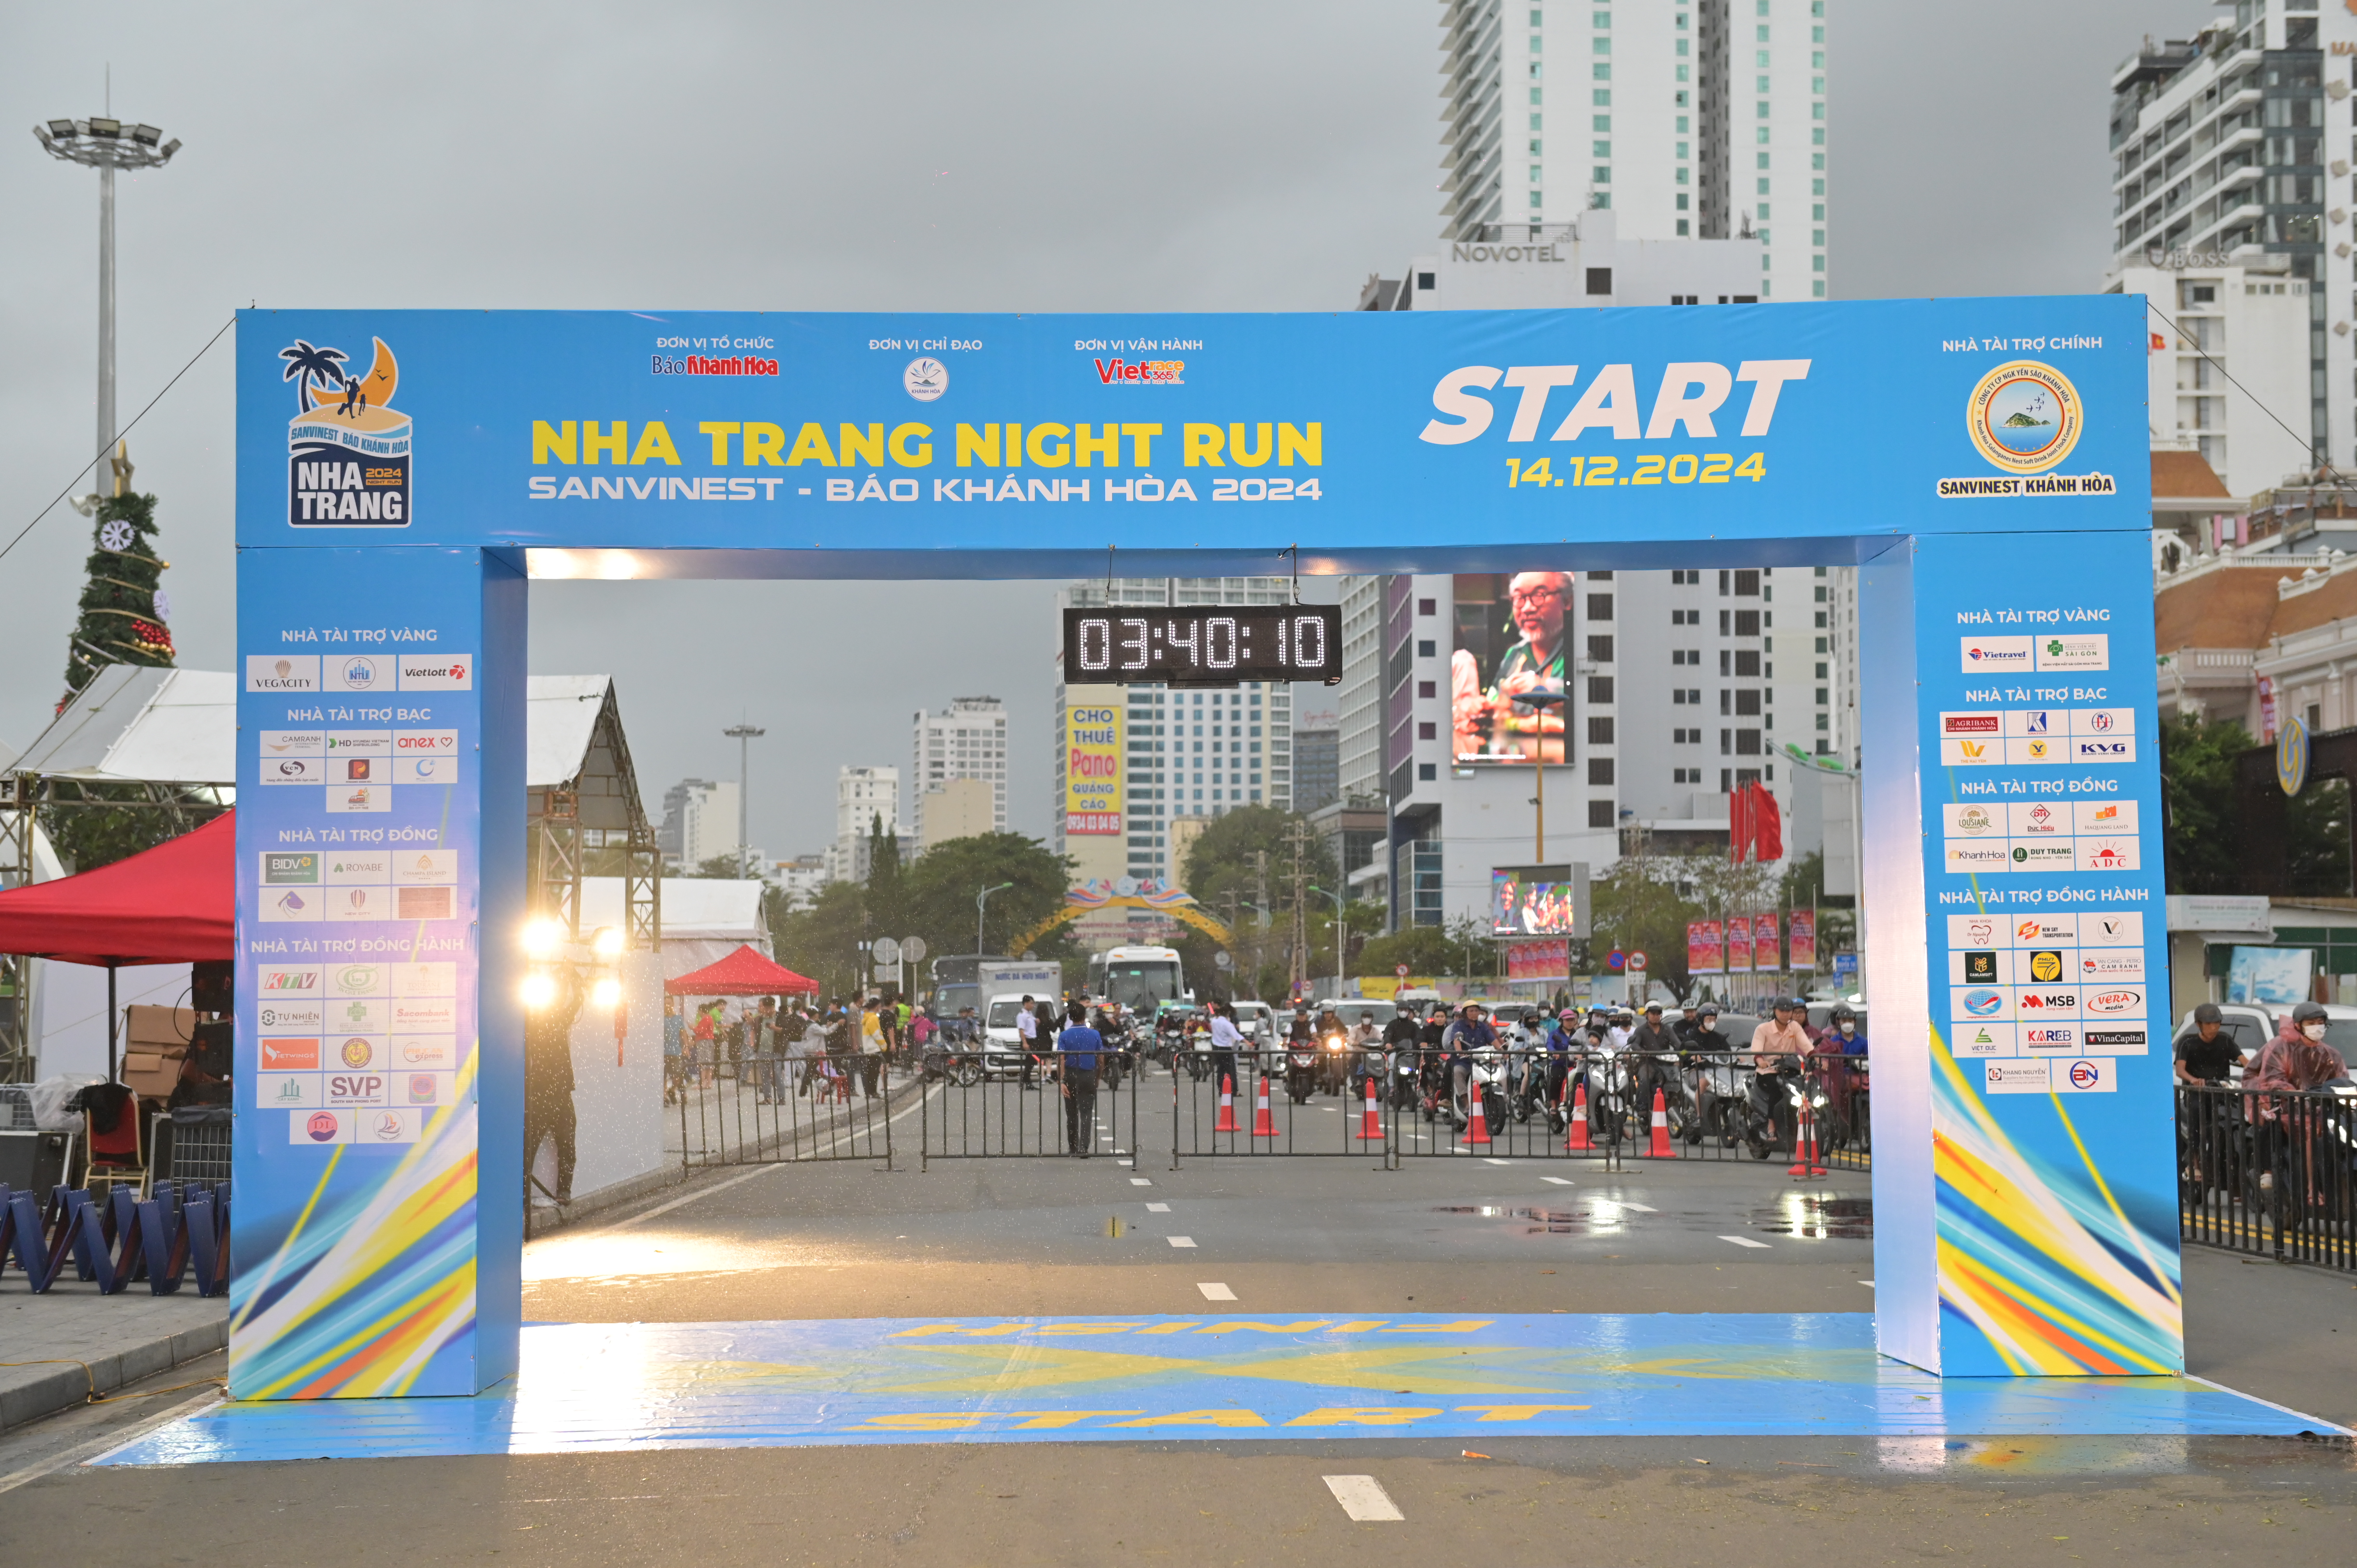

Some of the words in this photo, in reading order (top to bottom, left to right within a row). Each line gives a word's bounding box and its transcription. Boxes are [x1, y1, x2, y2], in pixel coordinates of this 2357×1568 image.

[1453, 242, 1565, 263] NOVOTEL
[2175, 252, 2230, 268] BOSS
[656, 337, 689, 348] ĐƠN
[693, 338, 707, 351] VỊ
[711, 335, 730, 348] TỔ
[733, 335, 774, 349] CHỨC
[869, 338, 901, 350] ĐƠN
[905, 340, 919, 352] VỊ
[923, 336, 947, 350] CHỈ
[951, 340, 982, 352] ĐẠO
[1074, 339, 1106, 350] ĐƠN
[1111, 340, 1124, 353] VỊ
[1128, 338, 1157, 353] VẬN
[1163, 338, 1203, 350] HÀNH
[1943, 337, 1978, 351] NHÀ
[1982, 336, 2007, 351] TÀI
[2012, 336, 2045, 353] TRỢ
[2050, 334, 2102, 349] CHÍNH
[1152, 371, 1174, 380] 365
[1979, 388, 1991, 405] CÔNG
[1987, 382, 1995, 391] TY
[1995, 376, 2002, 385] CP
[2002, 370, 2016, 381] NGK
[2016, 367, 2028, 376] YẾN
[2030, 369, 2042, 378] SÀO
[2042, 374, 2061, 391] KHÁNH
[2059, 389, 2069, 404] HÒA
[1418, 358, 1812, 445] START
[291, 426, 339, 441] SANVINEST
[343, 433, 359, 448] BÁO
[361, 439, 390, 454] KHÁNH
[392, 440, 409, 454] HÒA
[533, 420, 682, 465] NHA
[699, 421, 933, 468] TRANG
[956, 422, 1163, 468] NIGHT
[1184, 422, 1322, 467] RUN
[298, 462, 364, 490] NHA
[366, 468, 402, 478] 2024
[1505, 452, 1767, 488] 14.12.2024
[529, 477, 783, 501] SANVINEST
[827, 473, 919, 501] BÁO
[934, 473, 1090, 501] KHÁNH
[1105, 473, 1198, 501] HÒA
[1212, 478, 1322, 501] 2024
[1940, 480, 2020, 495] SANVINEST
[2026, 476, 2076, 493] KHÁNH
[2082, 475, 2113, 491] HÒA
[298, 491, 402, 520] TRANG
[1957, 609, 1993, 624] NHÀ
[1997, 608, 2021, 623] TÀI
[2026, 608, 2060, 625] TRỢ
[2064, 607, 2110, 622] VÀNG
[282, 627, 318, 642] NHÀ
[322, 627, 347, 642] TÀI
[353, 628, 386, 645] TRỢ
[390, 627, 437, 641] VÀNG
[1080, 616, 1324, 669] 03:40:10
[1966, 687, 2002, 702] NHÀ
[2005, 687, 2030, 701] TÀI
[2035, 687, 2068, 703] TRỢ
[2073, 688, 2107, 702] BẠC
[288, 706, 324, 721] NHÀ
[328, 706, 353, 720] TÀI
[358, 706, 392, 723] TRỢ
[397, 708, 431, 723] BẠC
[1074, 709, 1114, 723] CHO
[398, 737, 435, 748] anex
[1073, 727, 1115, 743] THUÊ
[2081, 743, 2126, 752] KVG
[1071, 747, 1116, 777] Pano
[1961, 779, 1997, 795] NHÀ
[2001, 779, 2026, 793] TÀI
[2031, 779, 2064, 796] TRỢ
[2068, 776, 2118, 792] ĐỒNG
[1959, 817, 1992, 827] LOUSIANE
[279, 827, 315, 842] NHÀ
[320, 827, 345, 841] TÀI
[350, 827, 384, 844] TRỢ
[388, 825, 438, 841] ĐỒNG
[1959, 851, 1986, 859] Khanh
[272, 859, 301, 869] BIDV
[1939, 889, 1975, 904] NHÀ
[1979, 888, 2004, 903] TÀI
[2009, 888, 2042, 905] TRỢ
[2046, 886, 2096, 902] ĐỒNG
[2101, 886, 2149, 901] HÀNH
[251, 938, 288, 953] NHÀ
[292, 938, 317, 952] TÀI
[322, 938, 356, 955] TRỢ
[361, 936, 410, 952] ĐỒNG
[415, 936, 464, 951] HÀNH
[265, 973, 318, 989] KTV
[2046, 996, 2075, 1006] MSB
[278, 1013, 290, 1021] TỰ
[292, 1012, 319, 1020] NHIÊN
[396, 1008, 450, 1017] Sacombank
[2096, 1034, 2143, 1044] VinaCapital
[330, 1077, 382, 1096] SVP
[314, 1121, 334, 1129] DL
[839, 1405, 1592, 1431] START
